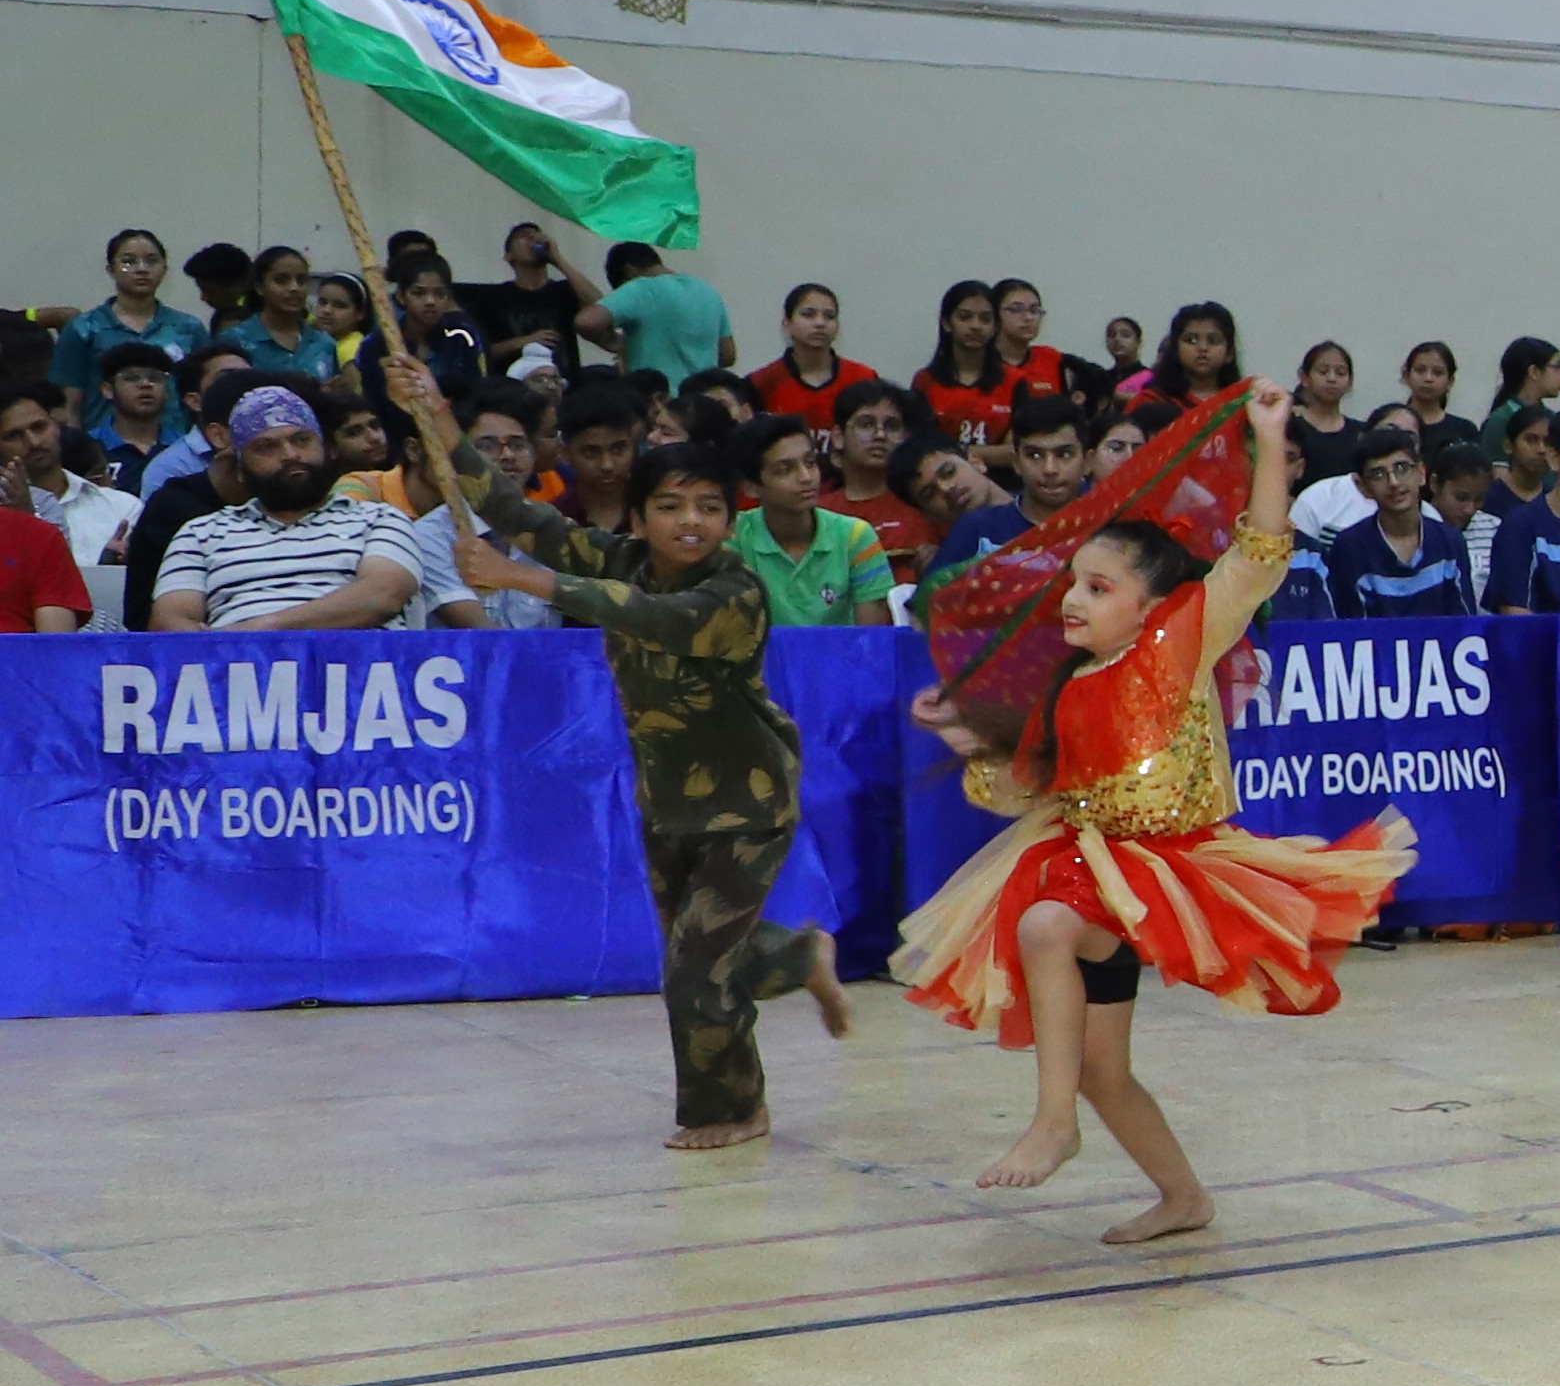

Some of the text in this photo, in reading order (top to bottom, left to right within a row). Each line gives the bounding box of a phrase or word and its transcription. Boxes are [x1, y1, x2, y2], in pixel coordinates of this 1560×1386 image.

[959, 419, 988, 446] 24
[101, 656, 468, 755] RAMJAS
[1238, 635, 1491, 729] RAMJAS
[1234, 746, 1506, 813] (DAY BOARDING)
[105, 780, 477, 852] (DAY BOARDING)
